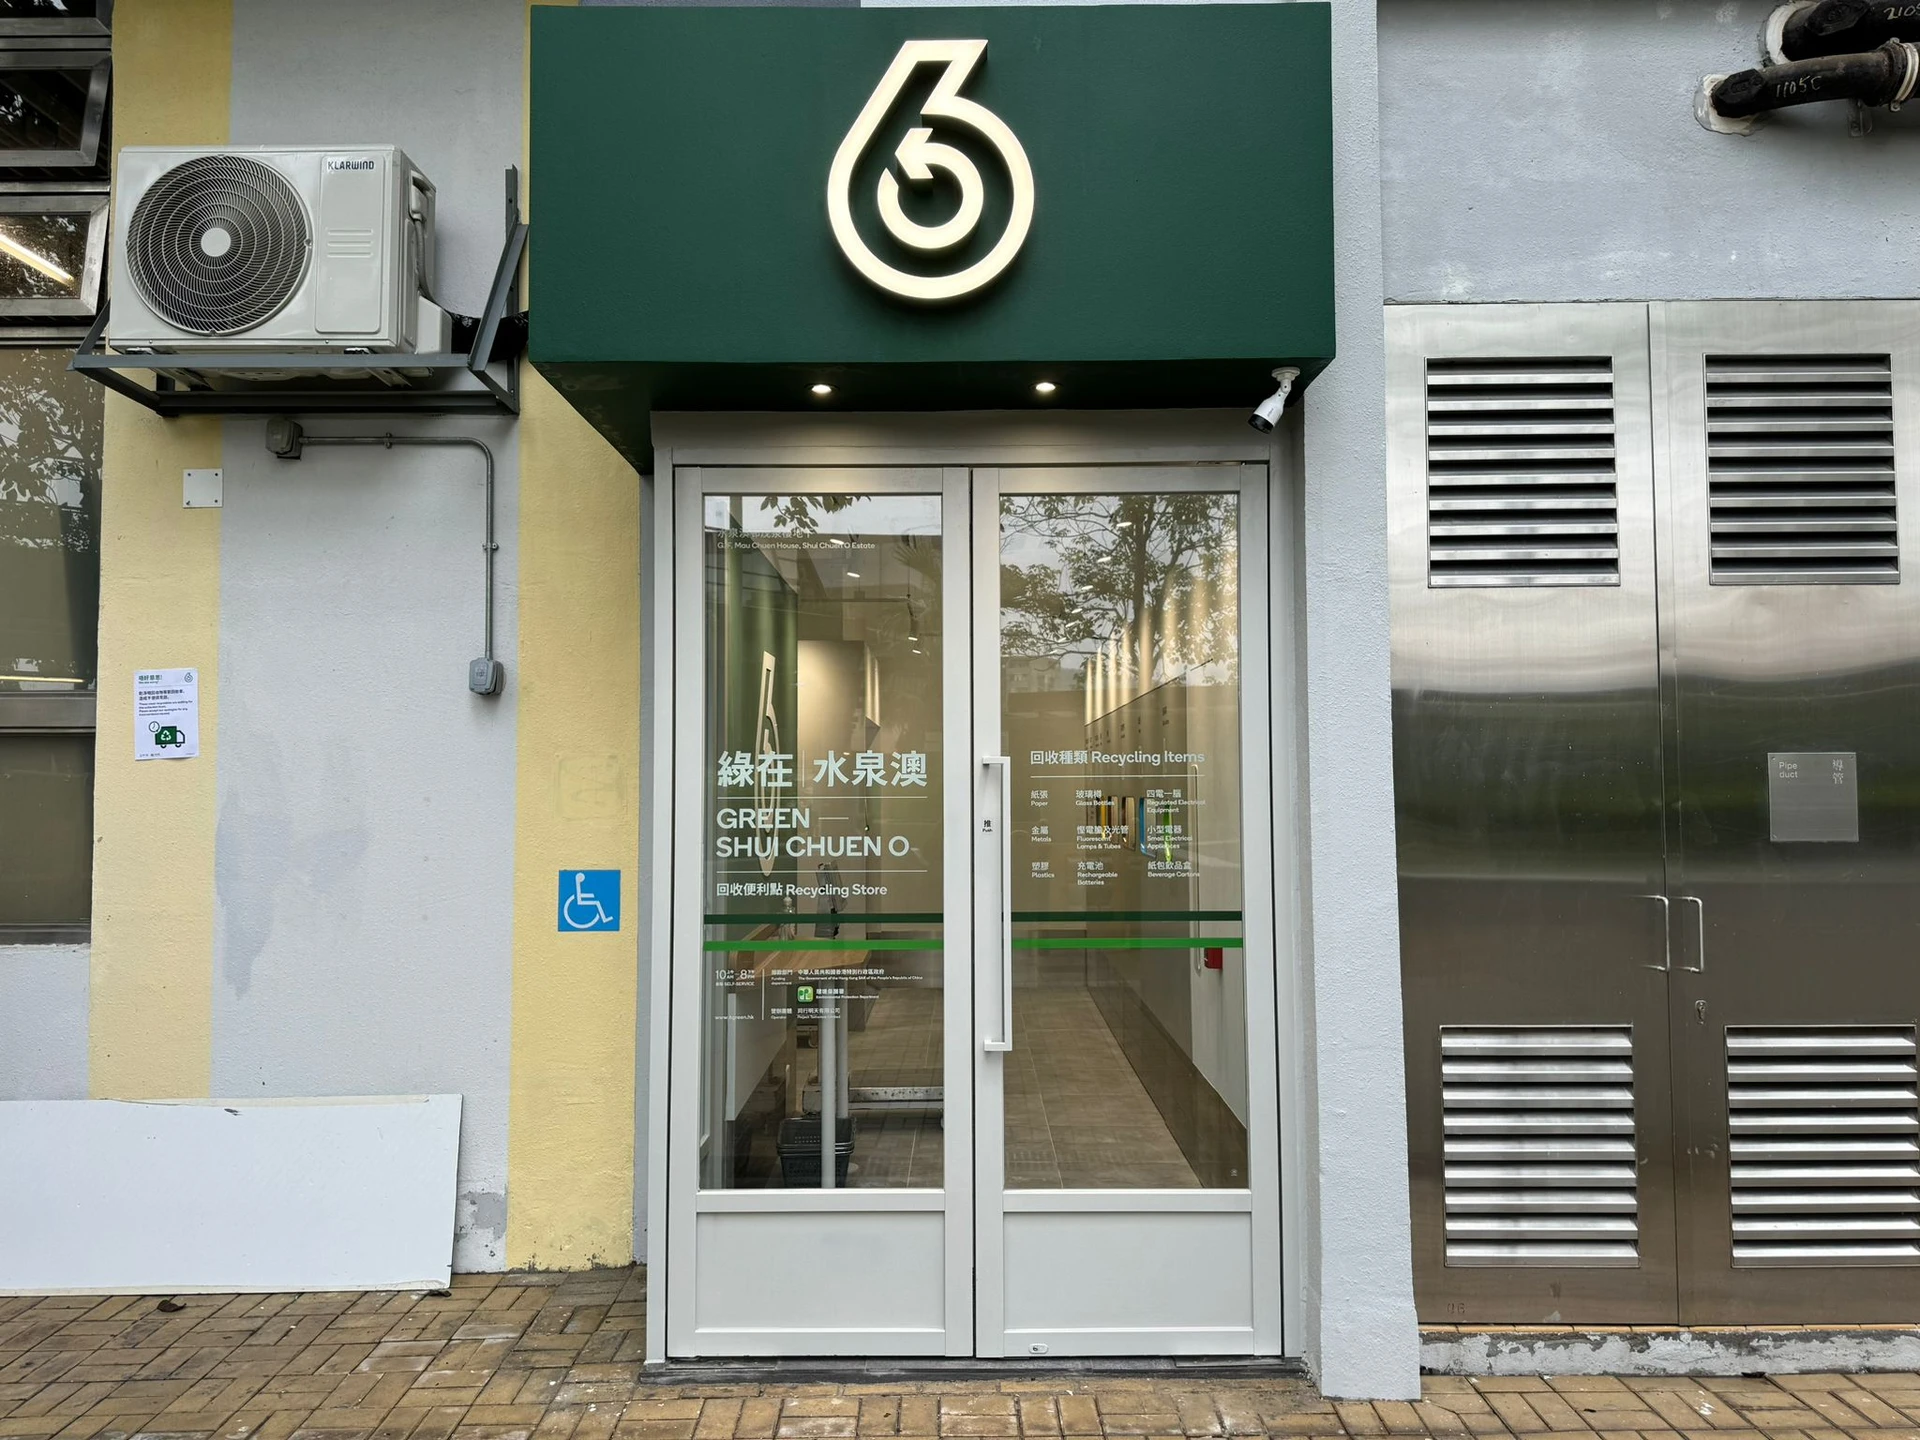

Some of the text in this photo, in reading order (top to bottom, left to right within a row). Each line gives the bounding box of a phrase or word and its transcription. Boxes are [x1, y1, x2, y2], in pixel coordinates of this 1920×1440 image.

[1776, 75, 1822, 98] 1105C
[328, 160, 374, 170] KLARWIND
[776, 542, 801, 550] House,
[1030, 750, 1206, 766] 回收種類 Recycling Items
[718, 750, 928, 788] 綠在 水泉澳
[1778, 761, 1798, 770] Pipe
[1779, 770, 1798, 778] duct
[1030, 790, 1048, 799] 紙張
[716, 808, 810, 829] GREEN
[1032, 826, 1048, 835] 金屬
[1147, 825, 1182, 834] 小型電器
[716, 836, 910, 858] SHUI CHUEN O
[1077, 861, 1104, 871] 充電池
[716, 882, 888, 898] 回收便利點 Recycling Store
[716, 969, 726, 980] 10
[740, 969, 748, 980] 8
